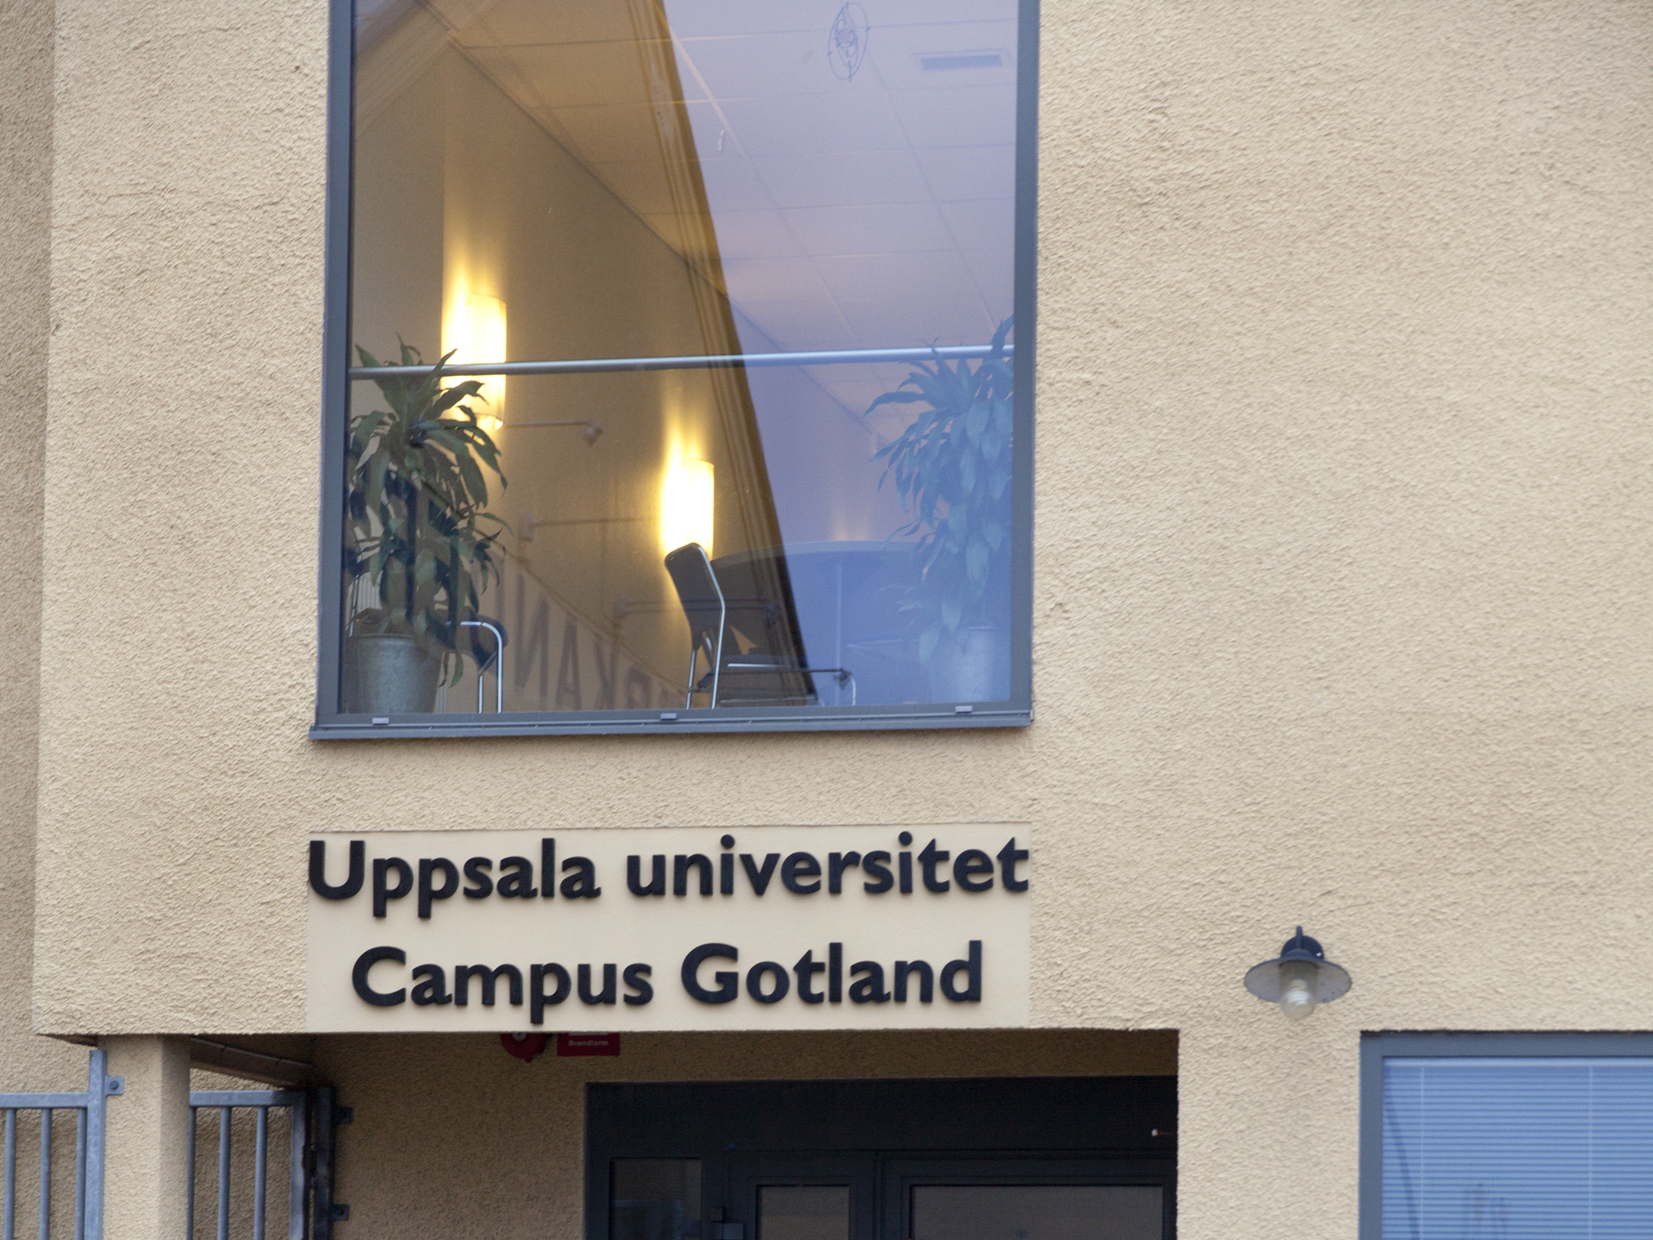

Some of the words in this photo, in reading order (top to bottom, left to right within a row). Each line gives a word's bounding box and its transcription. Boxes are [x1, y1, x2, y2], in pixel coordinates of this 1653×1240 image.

[308, 838, 601, 919] Uppsala
[626, 831, 1029, 897] universitet
[351, 946, 654, 1025] Campus
[680, 940, 983, 1006] Gotland
